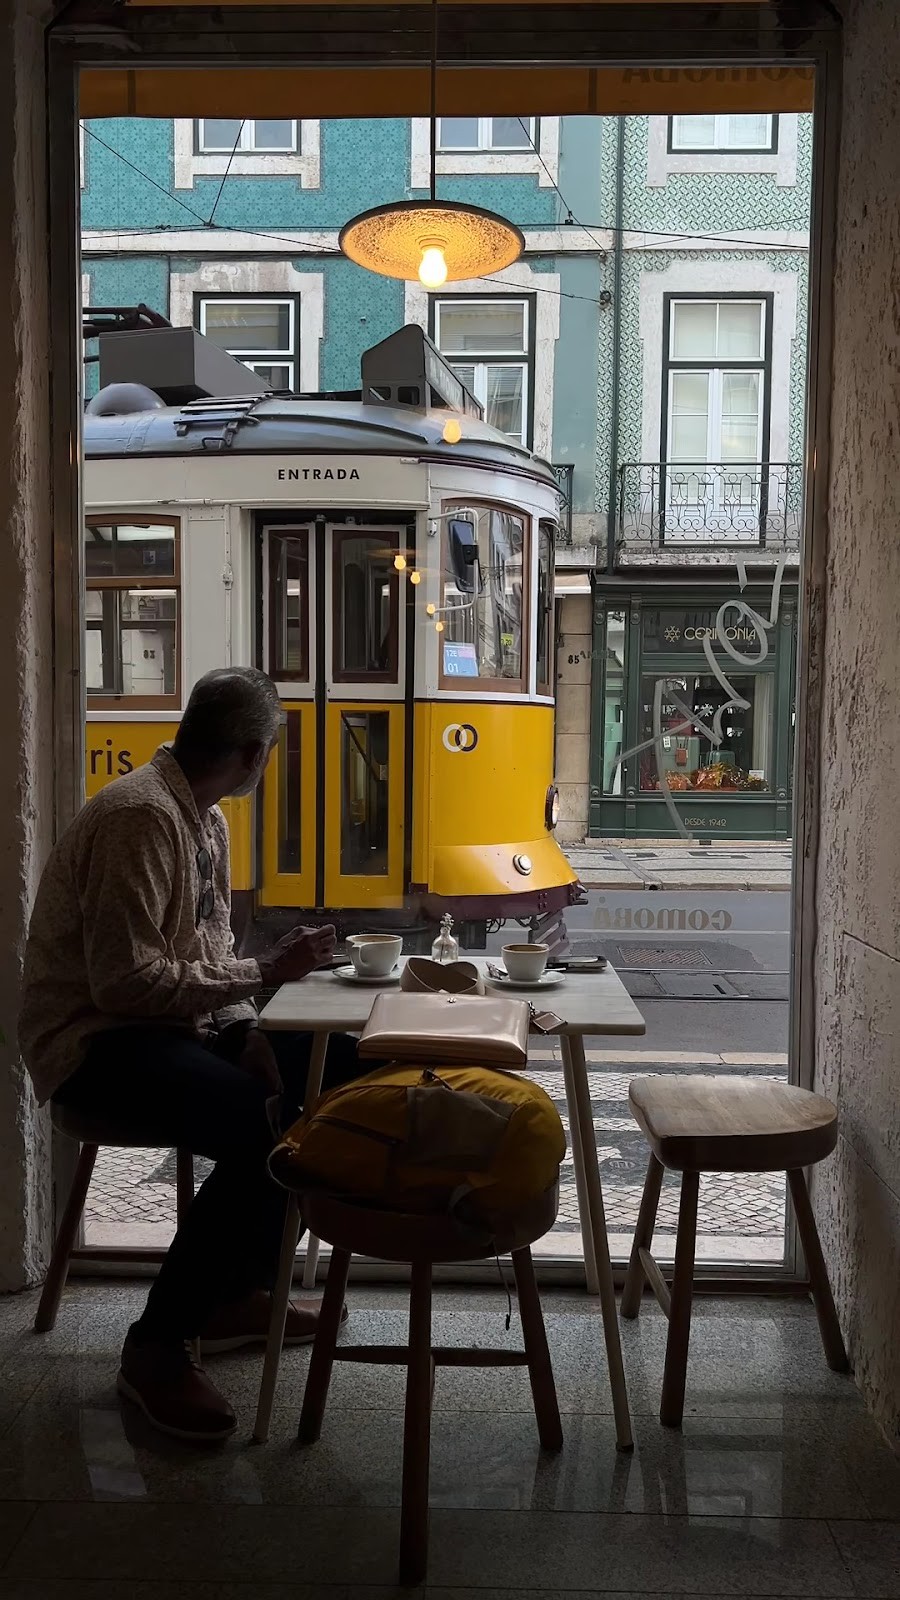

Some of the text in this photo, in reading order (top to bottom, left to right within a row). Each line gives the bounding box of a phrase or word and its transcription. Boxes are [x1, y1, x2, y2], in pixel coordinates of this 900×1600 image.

[278, 468, 360, 480] ENTRADA
[684, 625, 756, 641] CERIÓNIA
[86, 739, 133, 775] ris
[684, 817, 727, 827] DESDE 1942
